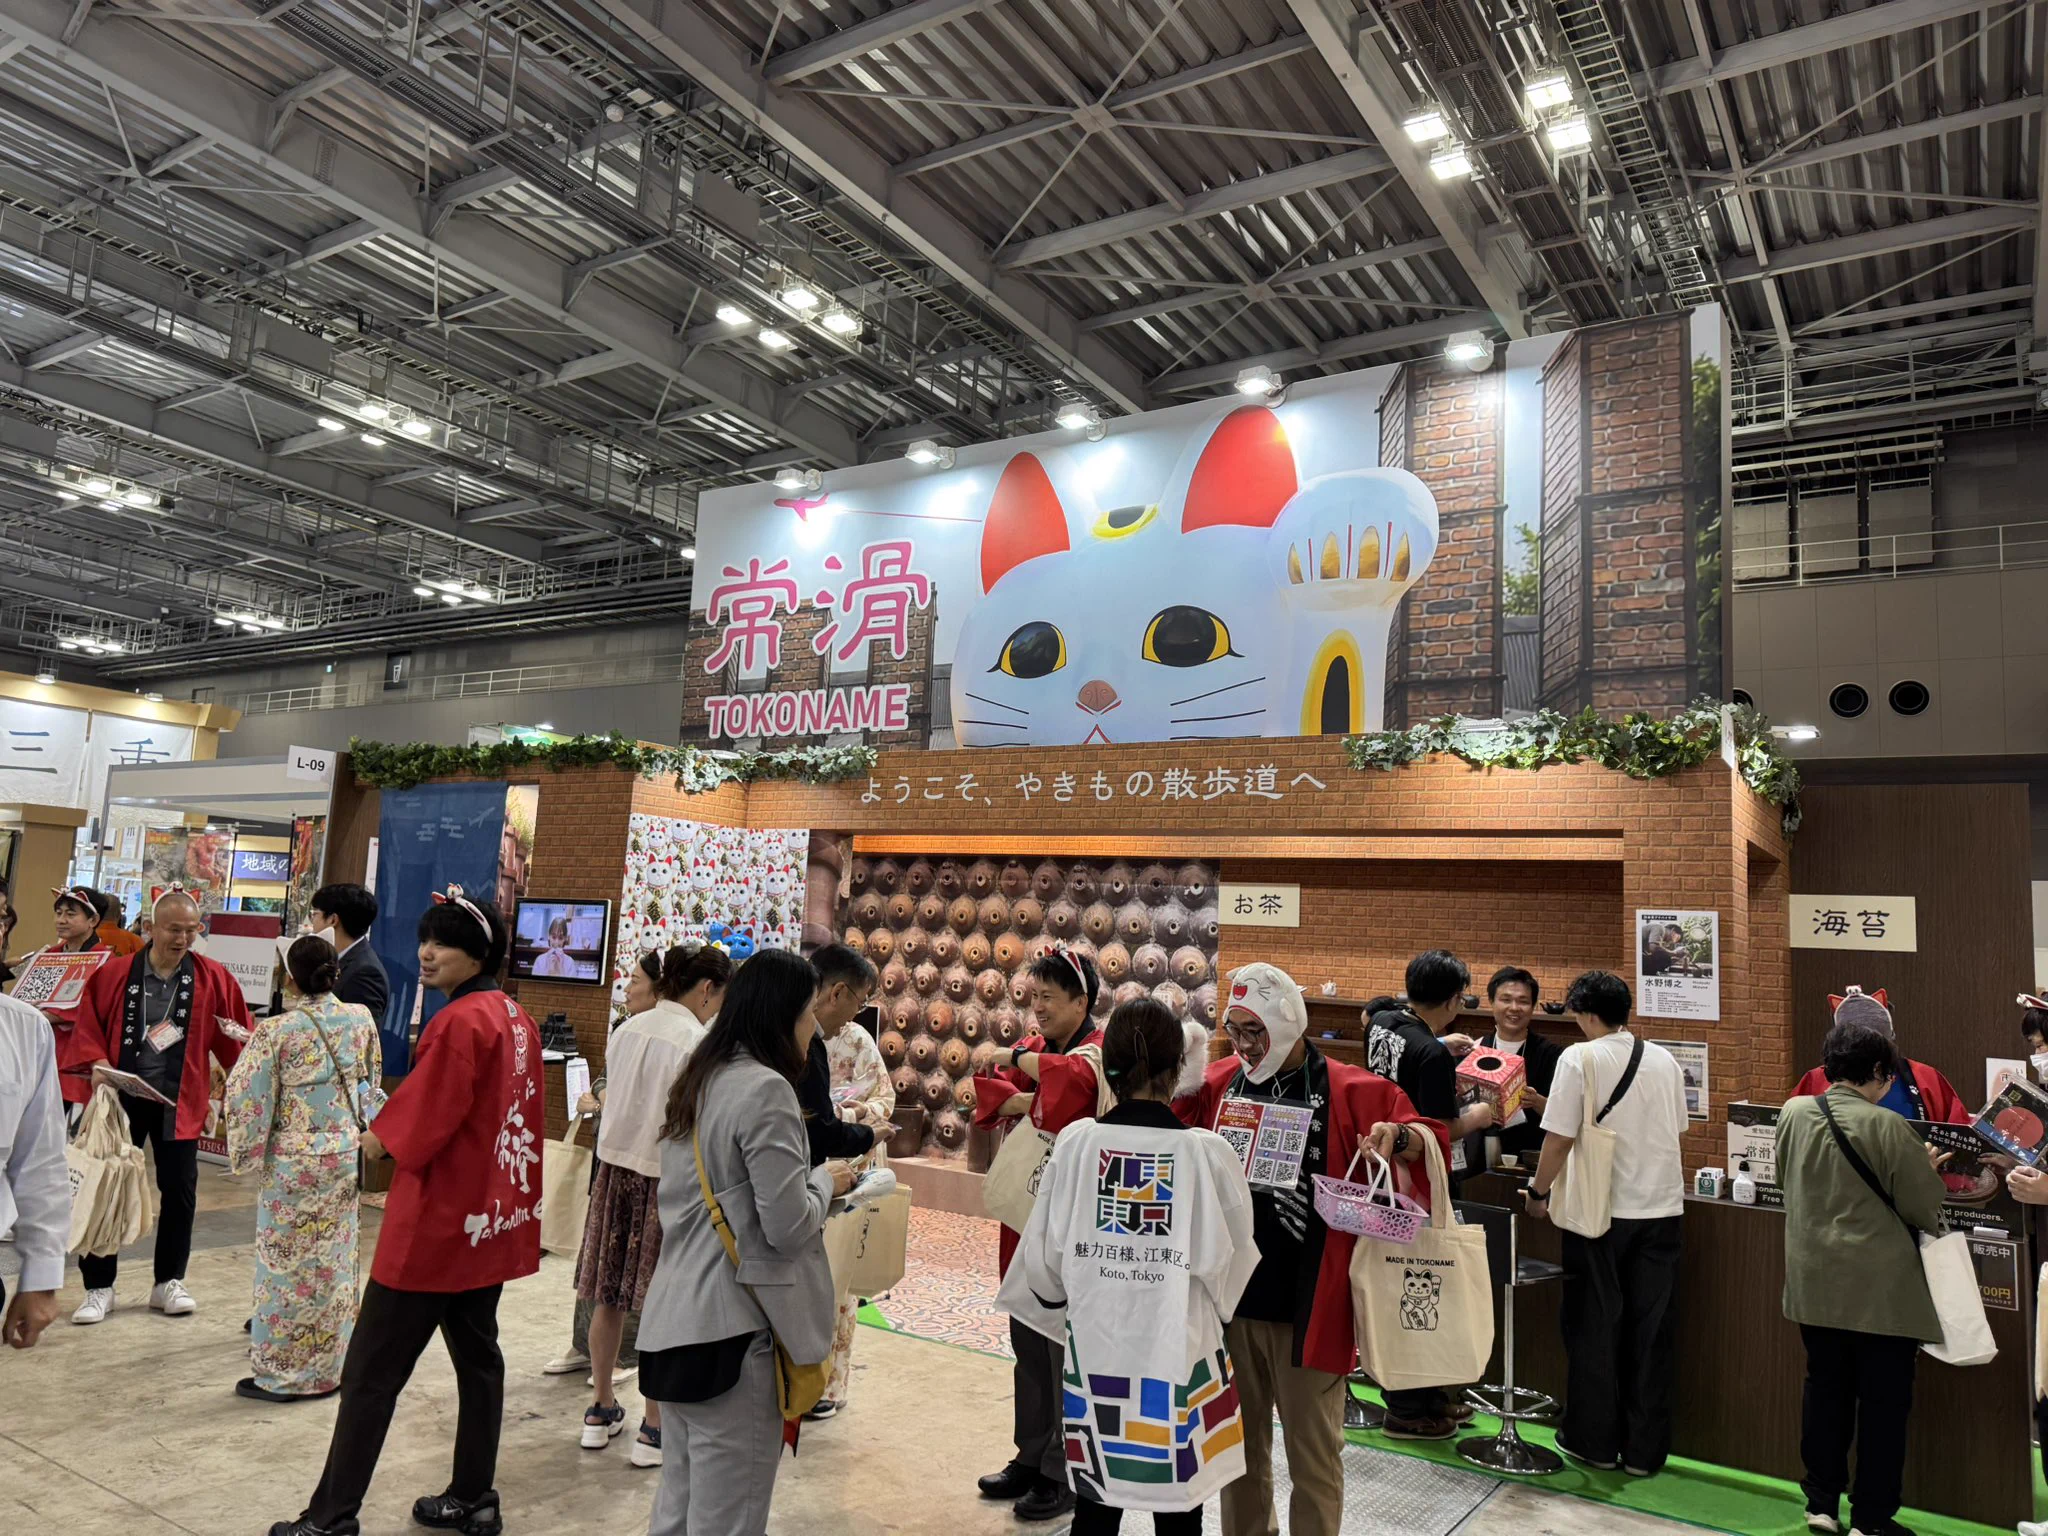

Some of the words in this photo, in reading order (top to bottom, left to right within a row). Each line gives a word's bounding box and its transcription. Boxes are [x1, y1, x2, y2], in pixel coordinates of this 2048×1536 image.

[704, 539, 930, 673] 常滑
[705, 685, 910, 737] TOKONAME
[297, 756, 325, 771] L-09
[859, 763, 1327, 806] ようこそ、やきもの散歩道へ
[1233, 893, 1284, 916] お茶
[1812, 909, 1890, 938] 海苔
[251, 965, 269, 975] BEEF
[1645, 978, 1683, 988] 水野博之
[124, 1000, 136, 1045] とこなめ
[1037, 1132, 1051, 1145] MADE
[198, 1139, 229, 1155] ATSUSA
[1745, 1145, 1775, 1159] 常滑
[1762, 1194, 1780, 1203] Free
[1954, 1210, 2004, 1222] producers.
[1074, 1241, 1191, 1270] 魅力百様、江東区。
[1973, 1243, 2010, 1258] 販売中
[1385, 1256, 1405, 1264] MADE
[1100, 1266, 1129, 1281] Koto,
[1131, 1270, 1165, 1282] Tokyo
